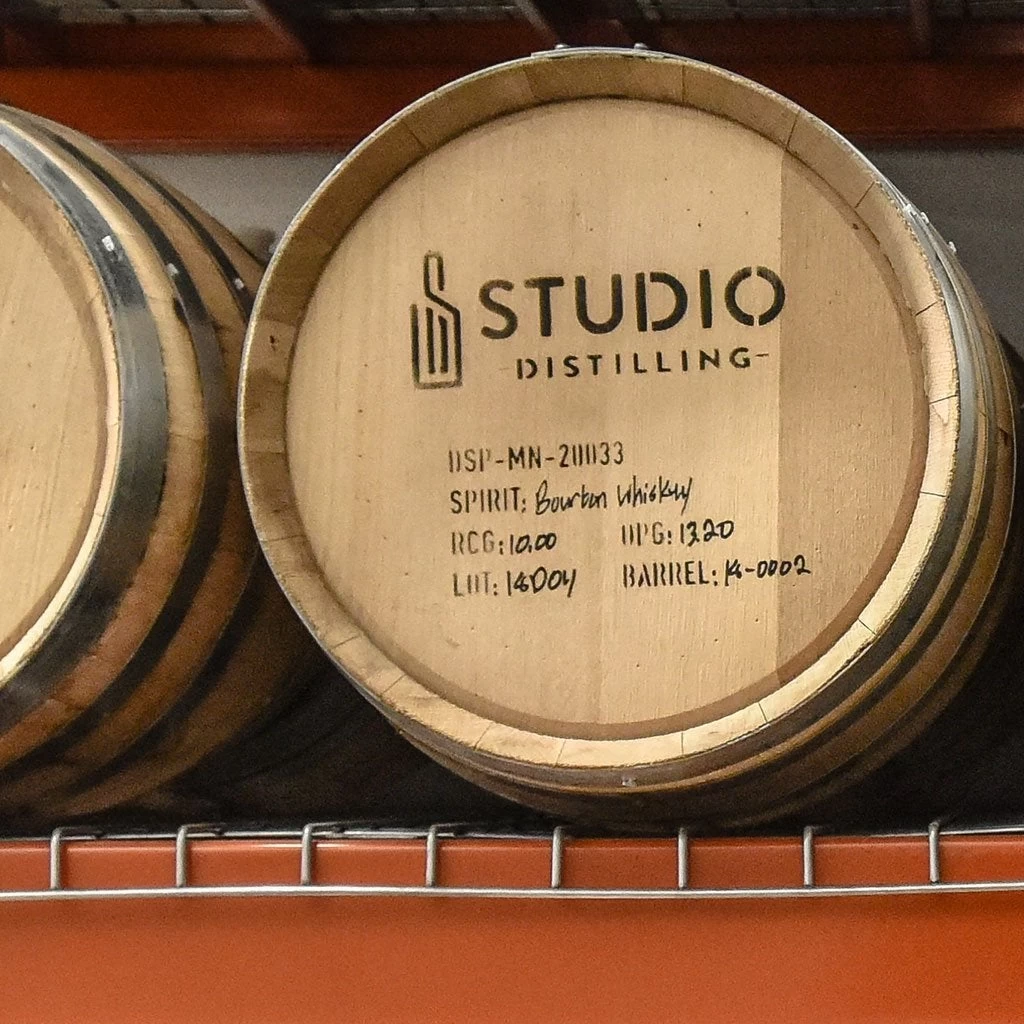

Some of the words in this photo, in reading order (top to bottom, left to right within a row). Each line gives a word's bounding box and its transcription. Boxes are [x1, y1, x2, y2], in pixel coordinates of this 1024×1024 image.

[478, 265, 786, 340] STUDIO
[450, 486, 527, 514] SPIRIT:
[535, 479, 607, 516] Bourbon
[451, 530, 504, 555] RCG:
[509, 532, 557, 556] 10.00
[622, 560, 718, 588] BARREL:
